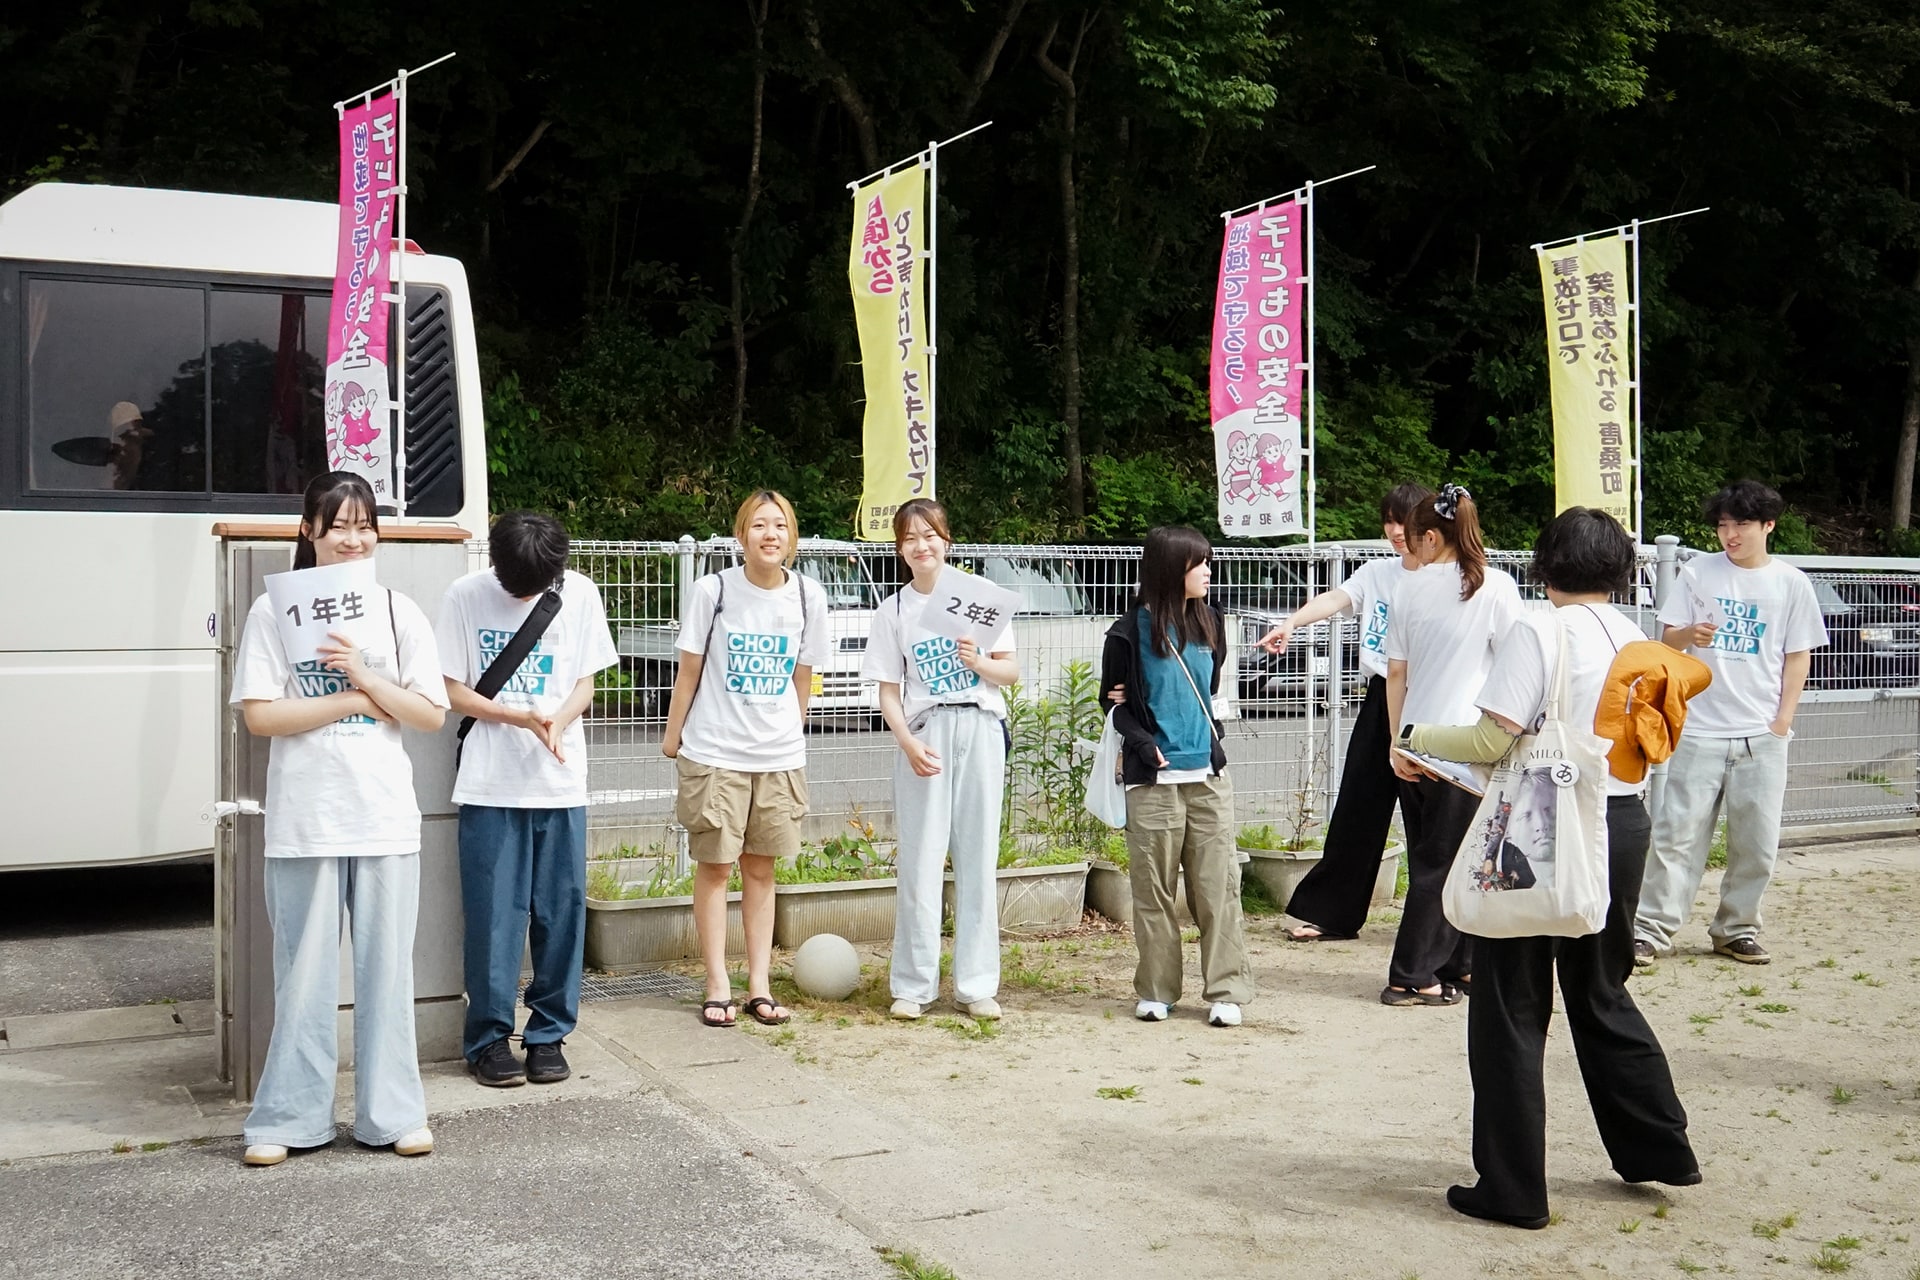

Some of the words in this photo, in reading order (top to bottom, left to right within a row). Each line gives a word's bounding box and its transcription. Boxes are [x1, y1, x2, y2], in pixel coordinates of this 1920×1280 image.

[1720, 618, 1760, 637] ORK
[728, 633, 781, 654] CHOI
[913, 636, 957, 661] CHO
[729, 655, 788, 674] WORK
[917, 653, 966, 681] WOR
[726, 675, 785, 695] CAMP
[1529, 749, 1563, 761] MILO
